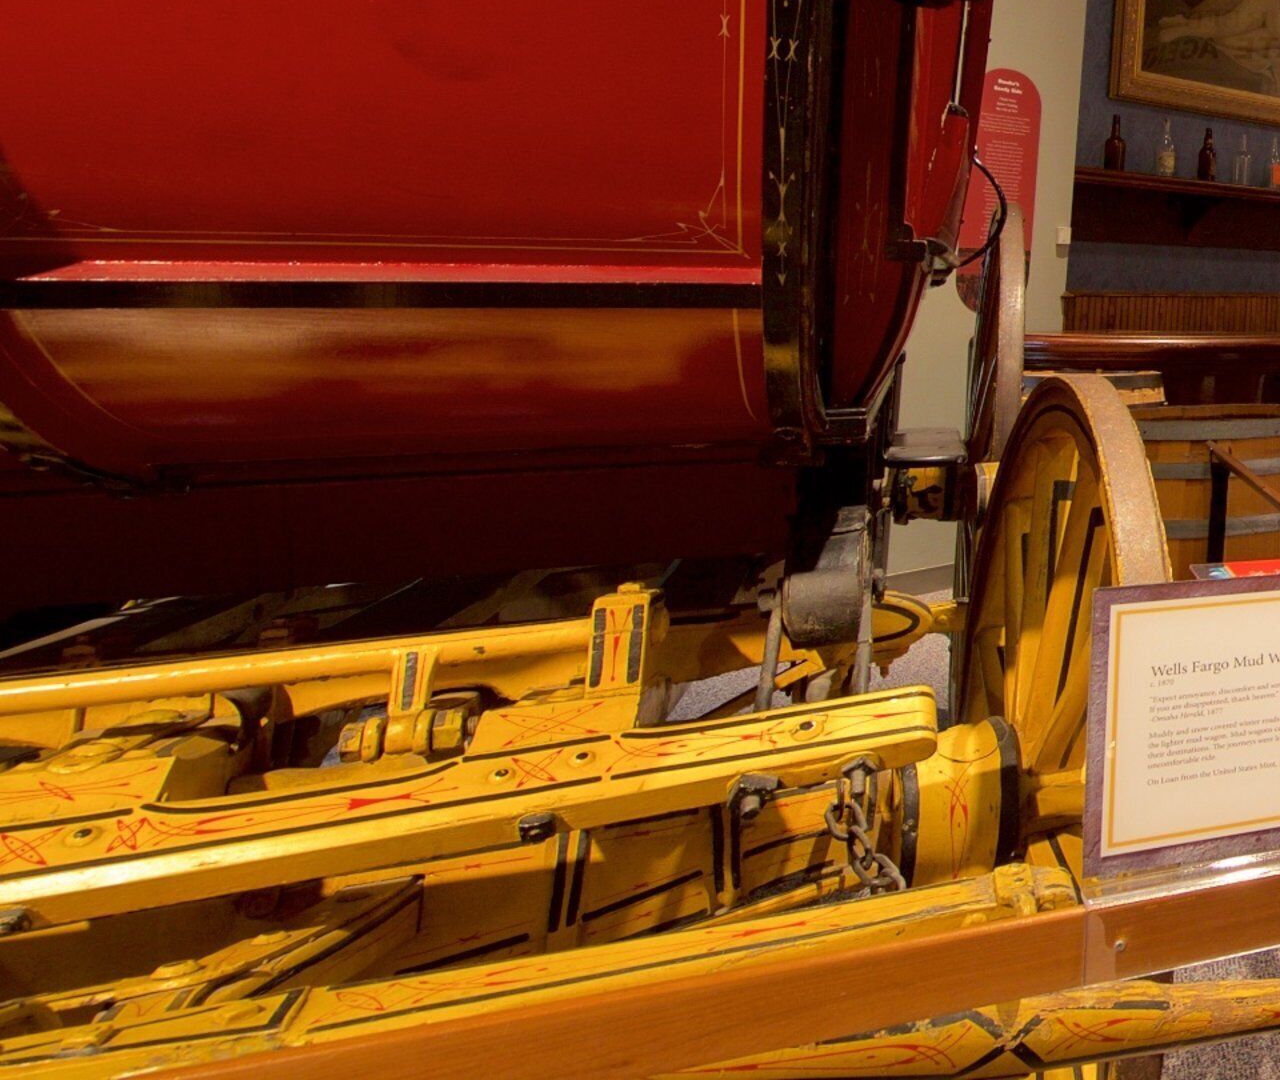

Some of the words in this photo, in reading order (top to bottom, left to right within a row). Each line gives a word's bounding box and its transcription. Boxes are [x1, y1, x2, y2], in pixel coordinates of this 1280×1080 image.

[1151, 662, 1187, 676] Wells
[1192, 660, 1228, 674] Fargo
[1233, 653, 1263, 667] Mud
[1157, 678, 1174, 686] 1870
[1218, 685, 1254, 694] discomfort
[1231, 694, 1249, 702] thank
[1207, 707, 1222, 715] 1877
[1148, 729, 1173, 739] Muddy
[1175, 727, 1188, 735] and
[1210, 721, 1237, 730] covered
[1261, 715, 1279, 723] roads
[1160, 739, 1183, 748] lighter
[1185, 735, 1202, 743] mud
[1230, 729, 1246, 737] Mud
[1248, 728, 1272, 736] wagons
[1225, 740, 1256, 749] journeys
[1147, 756, 1199, 768] uncomfortable
[1160, 776, 1178, 784] Loan
[1180, 773, 1198, 781] from
[1212, 766, 1236, 776] United
